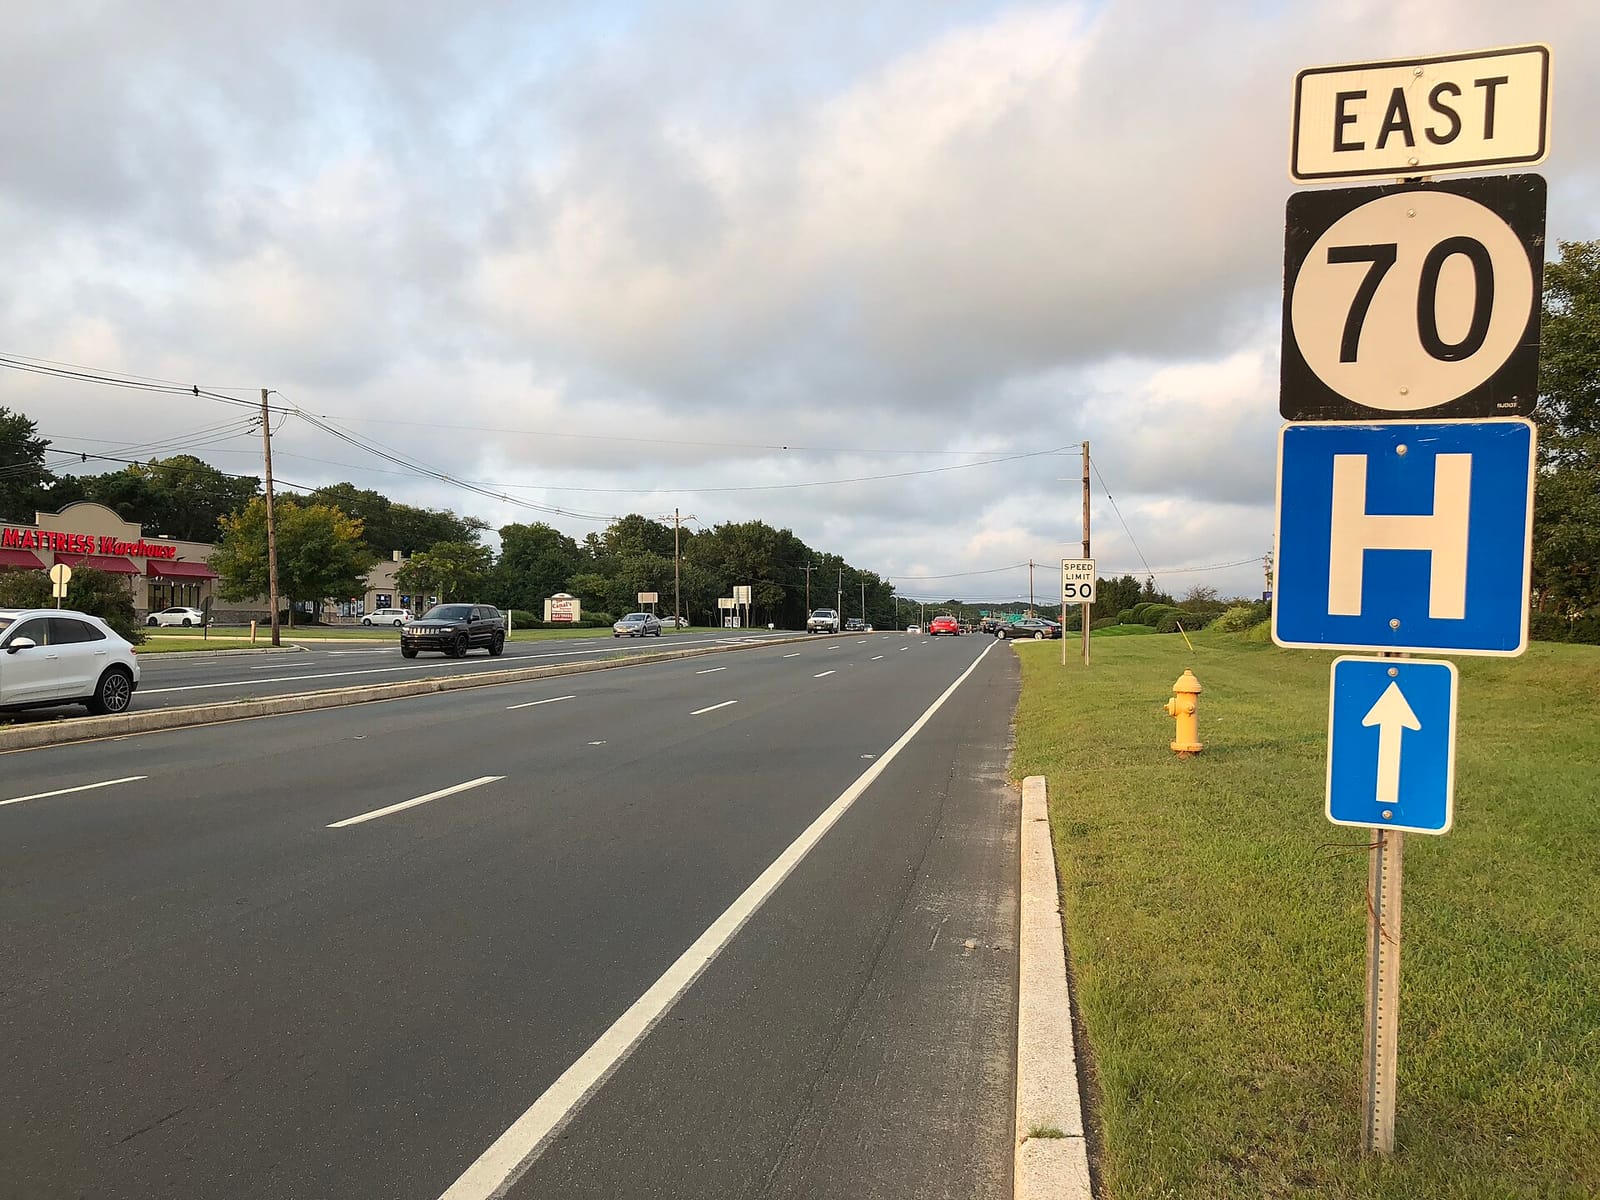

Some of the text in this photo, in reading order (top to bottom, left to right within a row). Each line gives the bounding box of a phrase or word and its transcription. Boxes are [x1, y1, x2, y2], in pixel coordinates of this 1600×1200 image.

[1333, 75, 1509, 152] EAST
[1327, 235, 1495, 363] 70
[2, 528, 177, 558] MATTRESS Warehouse
[1327, 453, 1473, 619] H
[1064, 583, 1092, 598] 50
